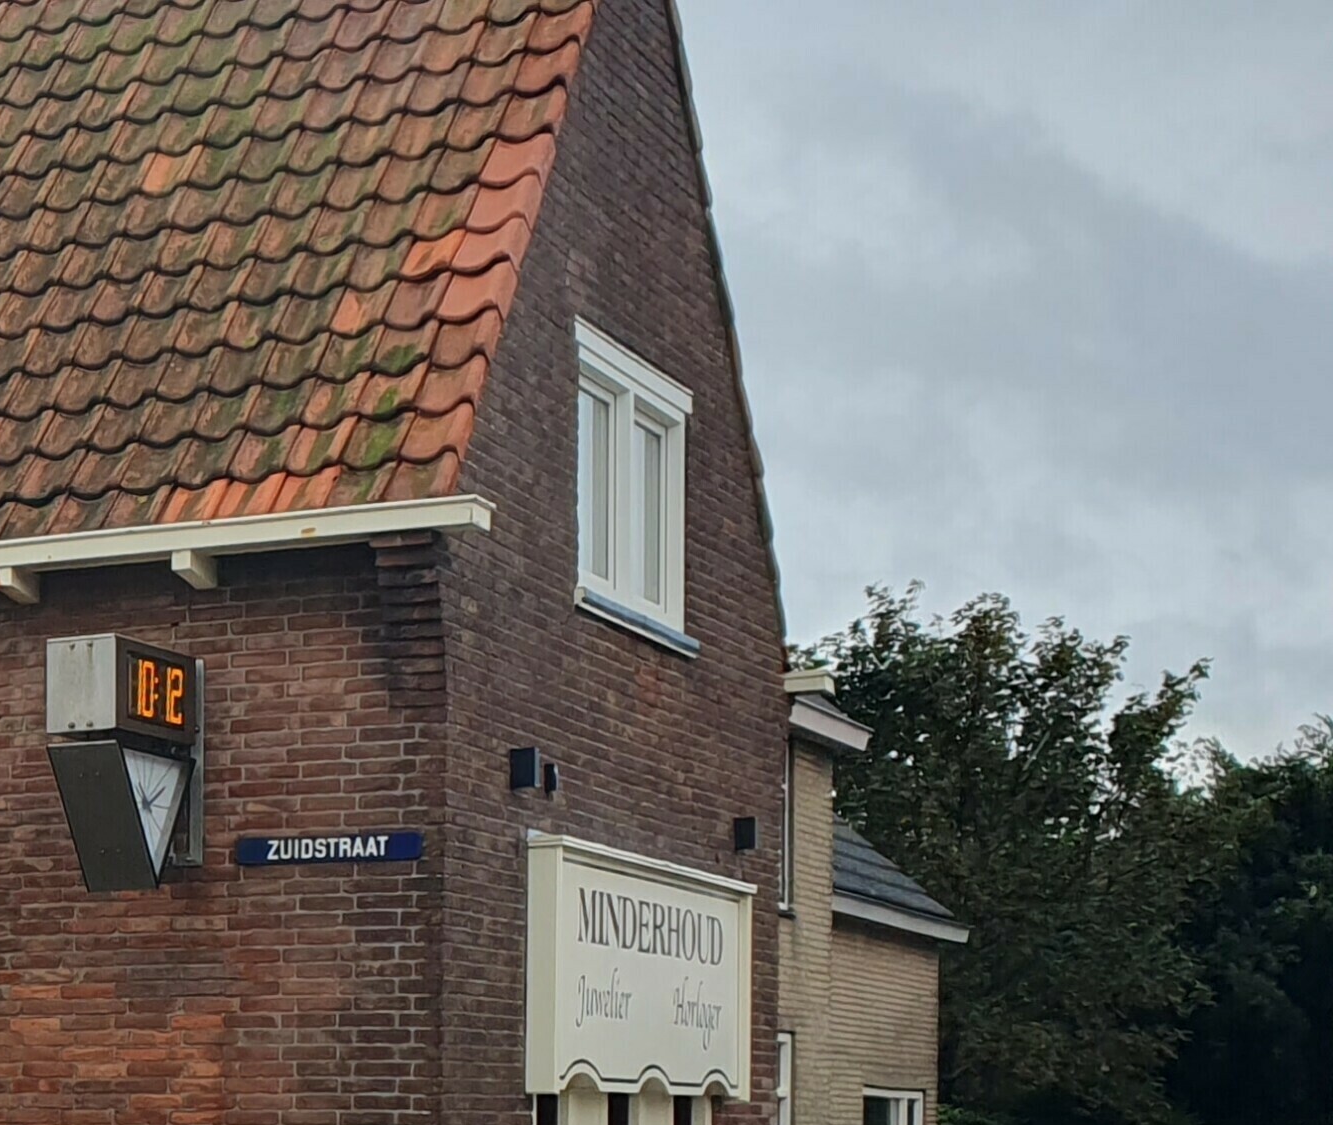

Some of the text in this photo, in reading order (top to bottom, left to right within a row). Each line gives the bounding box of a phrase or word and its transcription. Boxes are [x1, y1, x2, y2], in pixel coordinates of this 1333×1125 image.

[137, 659, 183, 725] 10:12
[266, 836, 389, 860] ZUIDSTRAAT
[577, 887, 723, 966] MINDERHOUD
[575, 967, 632, 1028] Juwelier
